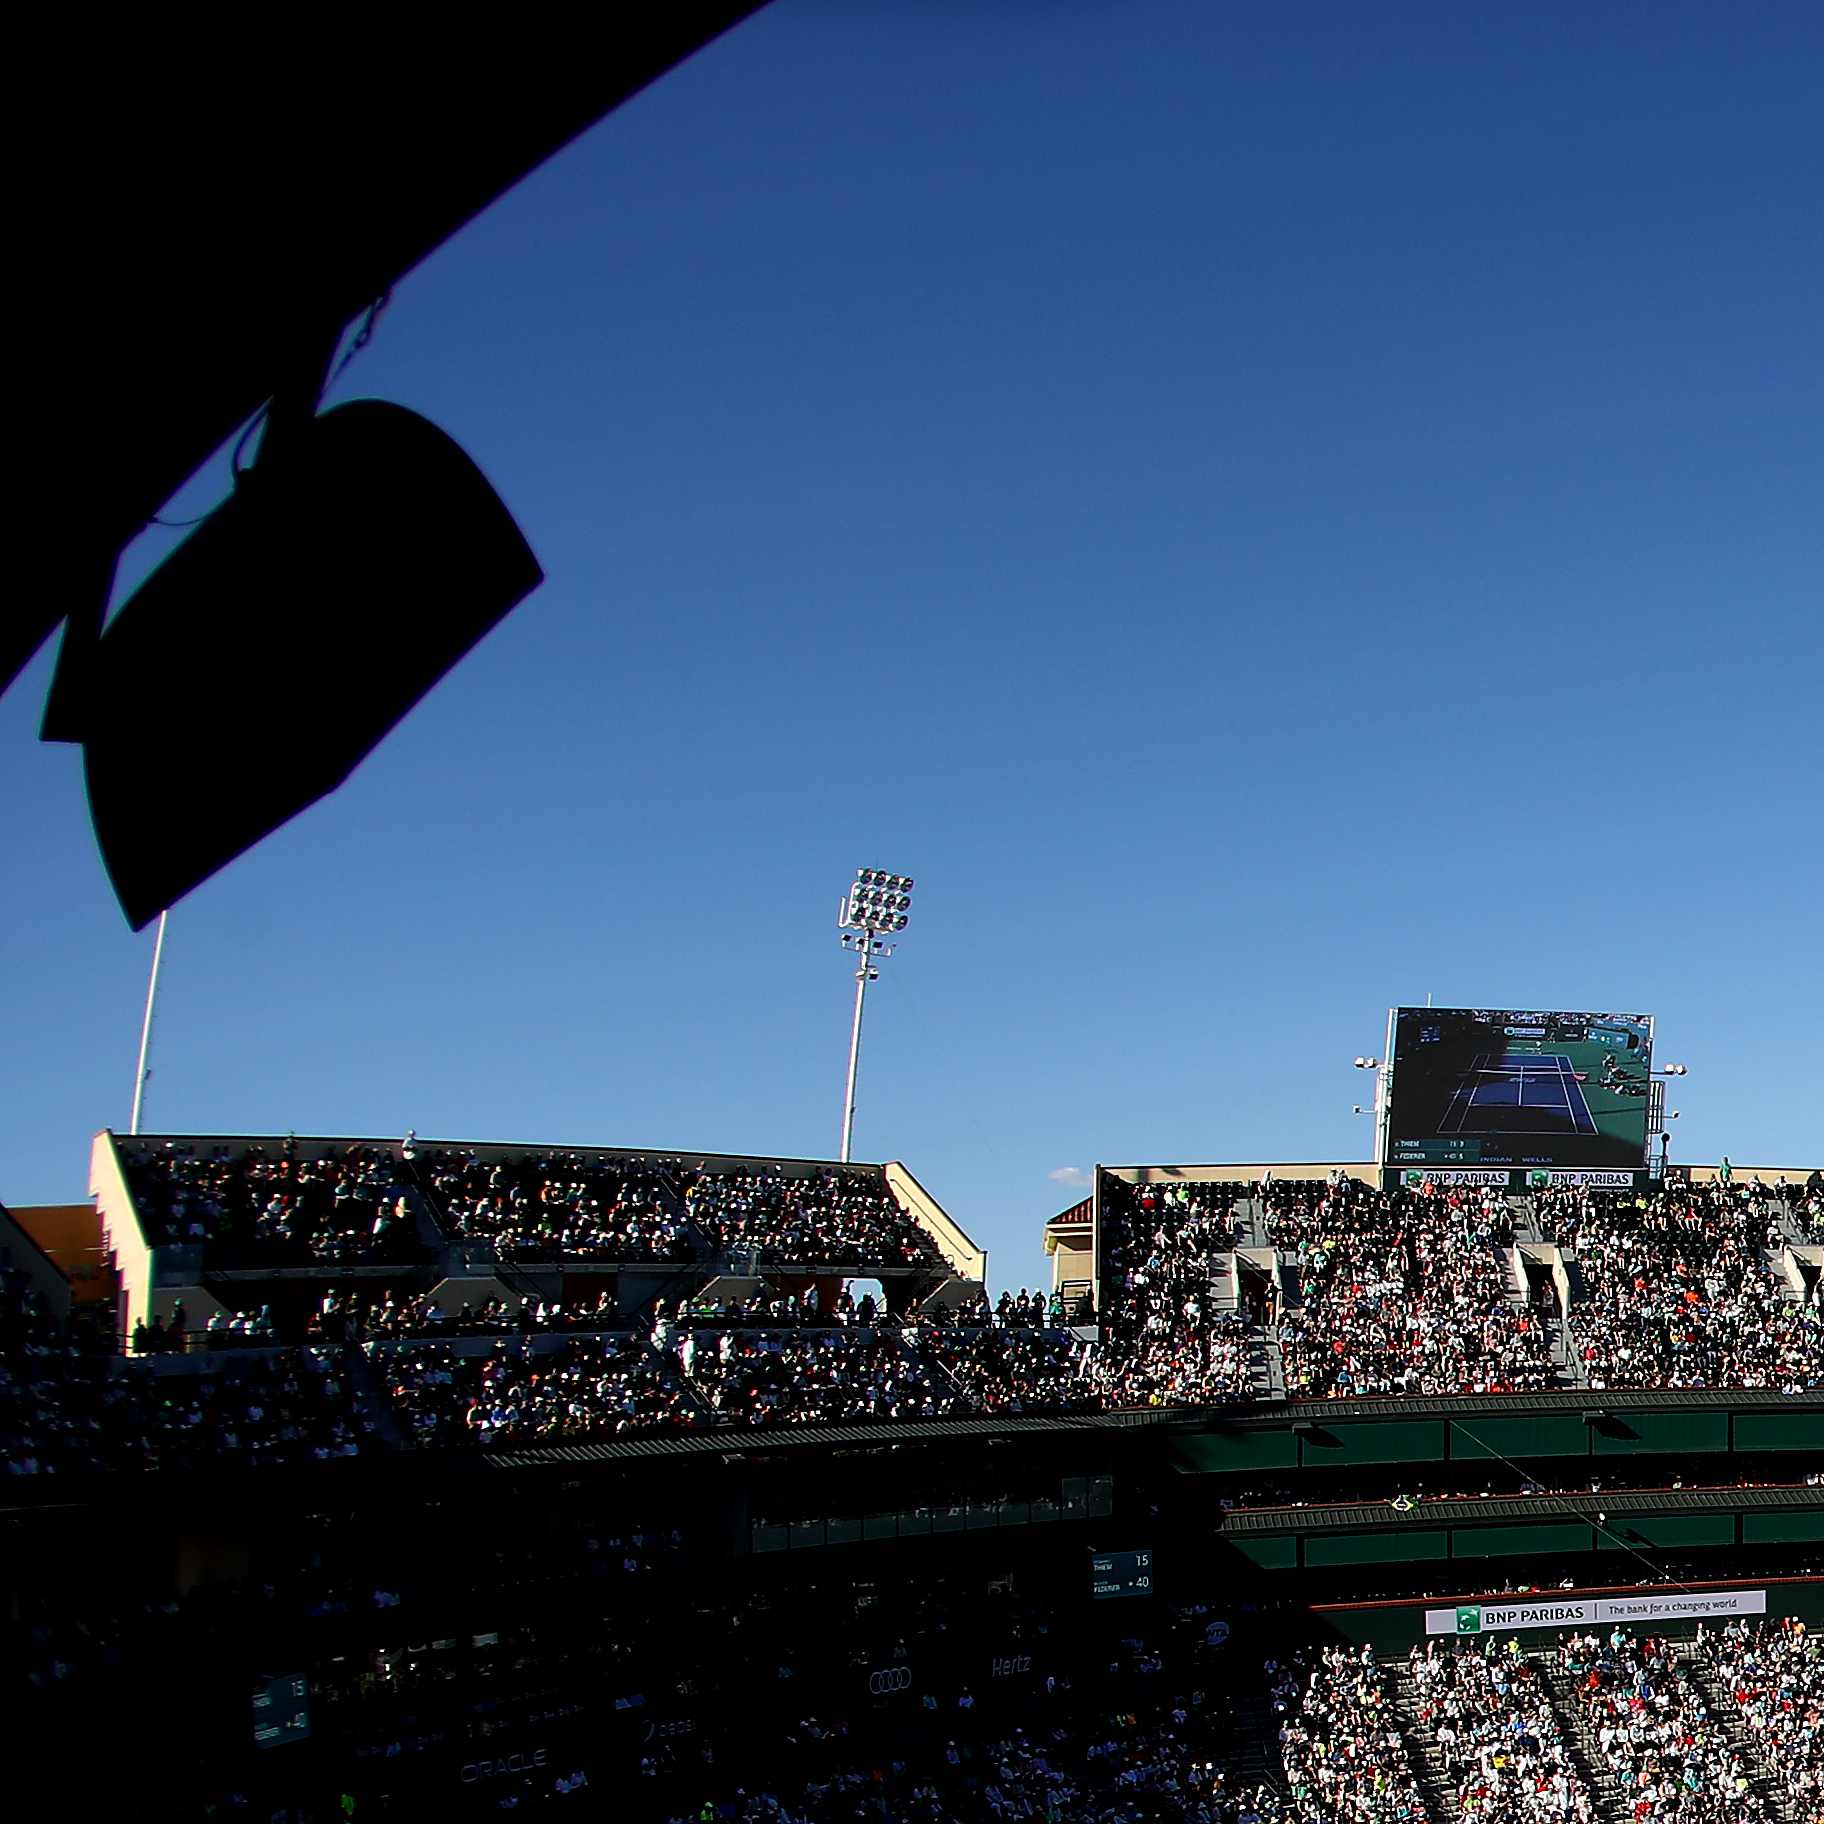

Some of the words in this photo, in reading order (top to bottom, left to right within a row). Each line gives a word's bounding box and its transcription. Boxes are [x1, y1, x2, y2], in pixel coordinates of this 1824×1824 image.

[1580, 1173, 1629, 1185] PARIBAS
[1608, 1605, 1625, 1615] The
[1627, 1603, 1648, 1614] bank
[1649, 1602, 1662, 1614] for
[1672, 1600, 1711, 1612] changing
[1712, 1599, 1738, 1609] world
[1485, 1609, 1516, 1625] BNP
[1520, 1606, 1584, 1622] PARIBAS
